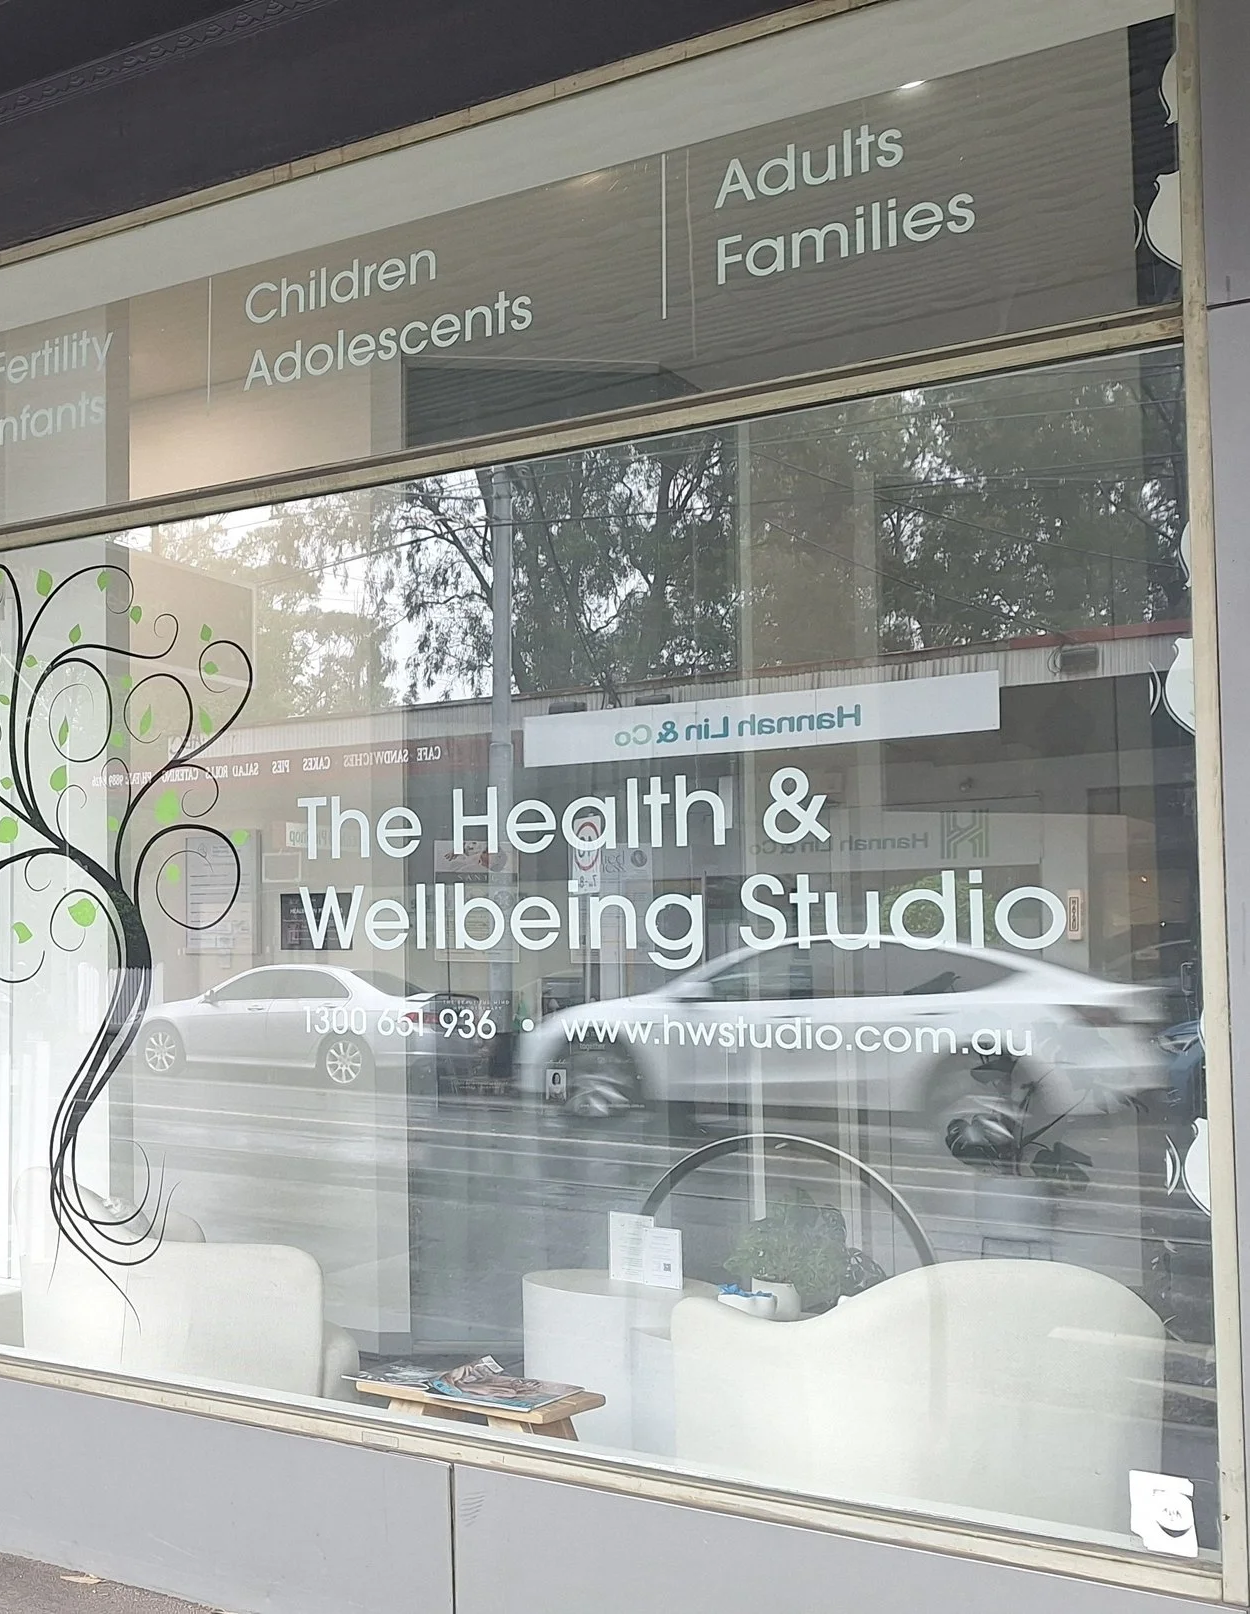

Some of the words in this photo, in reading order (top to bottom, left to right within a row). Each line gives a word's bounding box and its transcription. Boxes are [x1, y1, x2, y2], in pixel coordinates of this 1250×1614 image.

[714, 124, 904, 210] Adults
[716, 192, 976, 286] Families
[245, 248, 438, 325] Children
[243, 290, 533, 392] Adolescents
[297, 794, 423, 861] The
[453, 774, 726, 856] Health
[762, 766, 832, 844] &
[298, 882, 705, 971] Wellbeing
[738, 868, 1068, 951] Studio
[303, 1006, 368, 1037] 1300
[376, 1006, 426, 1038] 651
[439, 1008, 497, 1041] 936
[559, 1014, 1034, 1056] www.hwstudio.com.au
